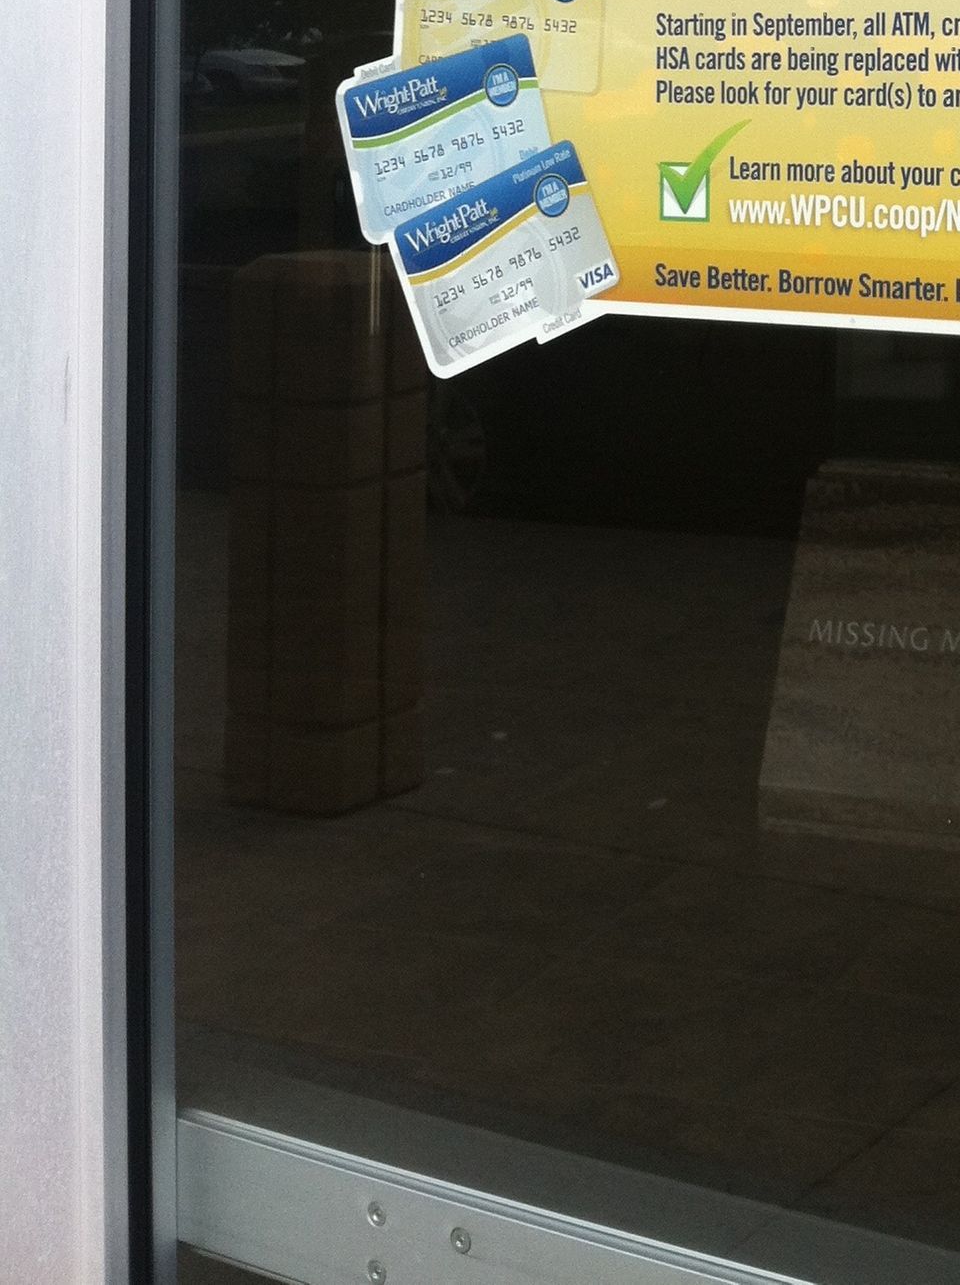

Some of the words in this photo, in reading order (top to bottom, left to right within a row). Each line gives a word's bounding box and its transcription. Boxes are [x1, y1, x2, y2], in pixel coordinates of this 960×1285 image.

[420, 9, 453, 24] 1234
[460, 12, 493, 26] 5678
[501, 15, 535, 31] 9876
[543, 19, 577, 34] 5432
[656, 13, 726, 41] Starting
[731, 13, 747, 36] in
[752, 13, 858, 42] September,
[863, 12, 887, 36] all
[892, 12, 935, 40] ATM,
[656, 46, 690, 71] HSA
[694, 46, 746, 71] cards
[751, 52, 781, 71] are
[787, 47, 839, 76] being
[844, 47, 929, 76] replaced
[656, 80, 715, 105] Please
[720, 81, 758, 106] look
[764, 81, 791, 106] for
[796, 86, 839, 111] your
[843, 82, 912, 110] card(s)
[917, 86, 937, 108] to
[374, 156, 406, 175] 1234
[413, 144, 445, 163] 5678
[451, 135, 485, 154] 9876
[492, 119, 525, 140] 5432
[440, 162, 473, 180] 12/99
[729, 156, 781, 181] Learn
[787, 162, 836, 182] more
[840, 159, 895, 185] about
[900, 165, 945, 190] your
[383, 189, 447, 217] CARDHOLDER
[434, 285, 465, 308] 1234
[472, 265, 504, 290] 5678
[509, 247, 542, 270] 9876
[549, 226, 581, 252] 5432
[578, 263, 615, 290] VISA
[500, 277, 533, 302] 12/99
[654, 263, 701, 289] Save
[707, 265, 772, 293] Better.
[778, 270, 852, 297] Borrow
[858, 273, 949, 302] Smarter.
[448, 311, 511, 348] CARDHOLDER
[511, 296, 540, 318] NAME
[808, 619, 929, 652] MISSING
